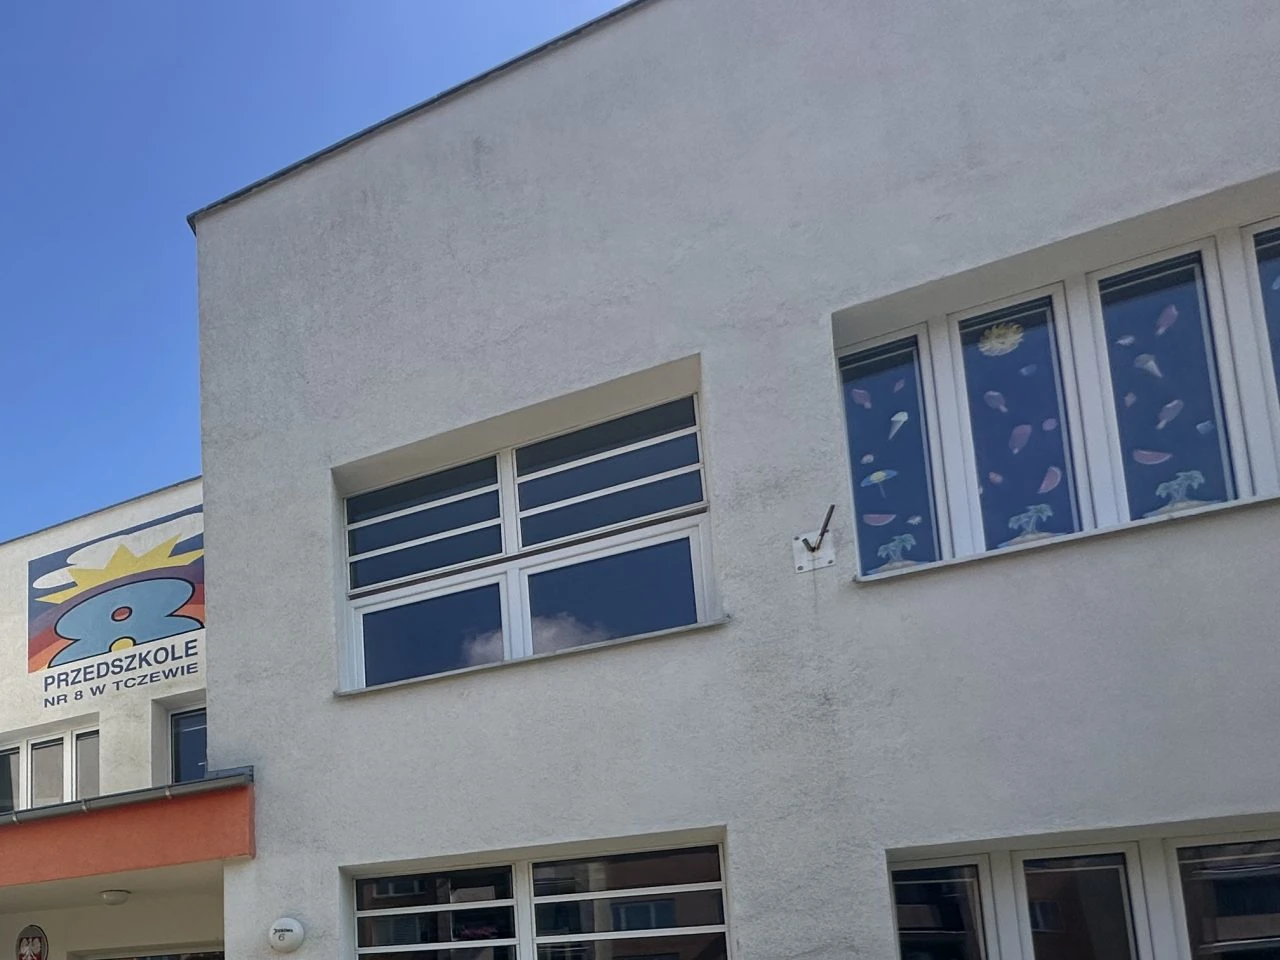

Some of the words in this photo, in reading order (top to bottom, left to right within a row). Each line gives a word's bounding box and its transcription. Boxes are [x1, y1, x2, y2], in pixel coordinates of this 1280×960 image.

[44, 639, 198, 692] PRZEDSZKOLE
[44, 694, 68, 708] NR
[74, 690, 83, 701] 8
[90, 684, 106, 696] W
[112, 662, 198, 691] TCZEWIE
